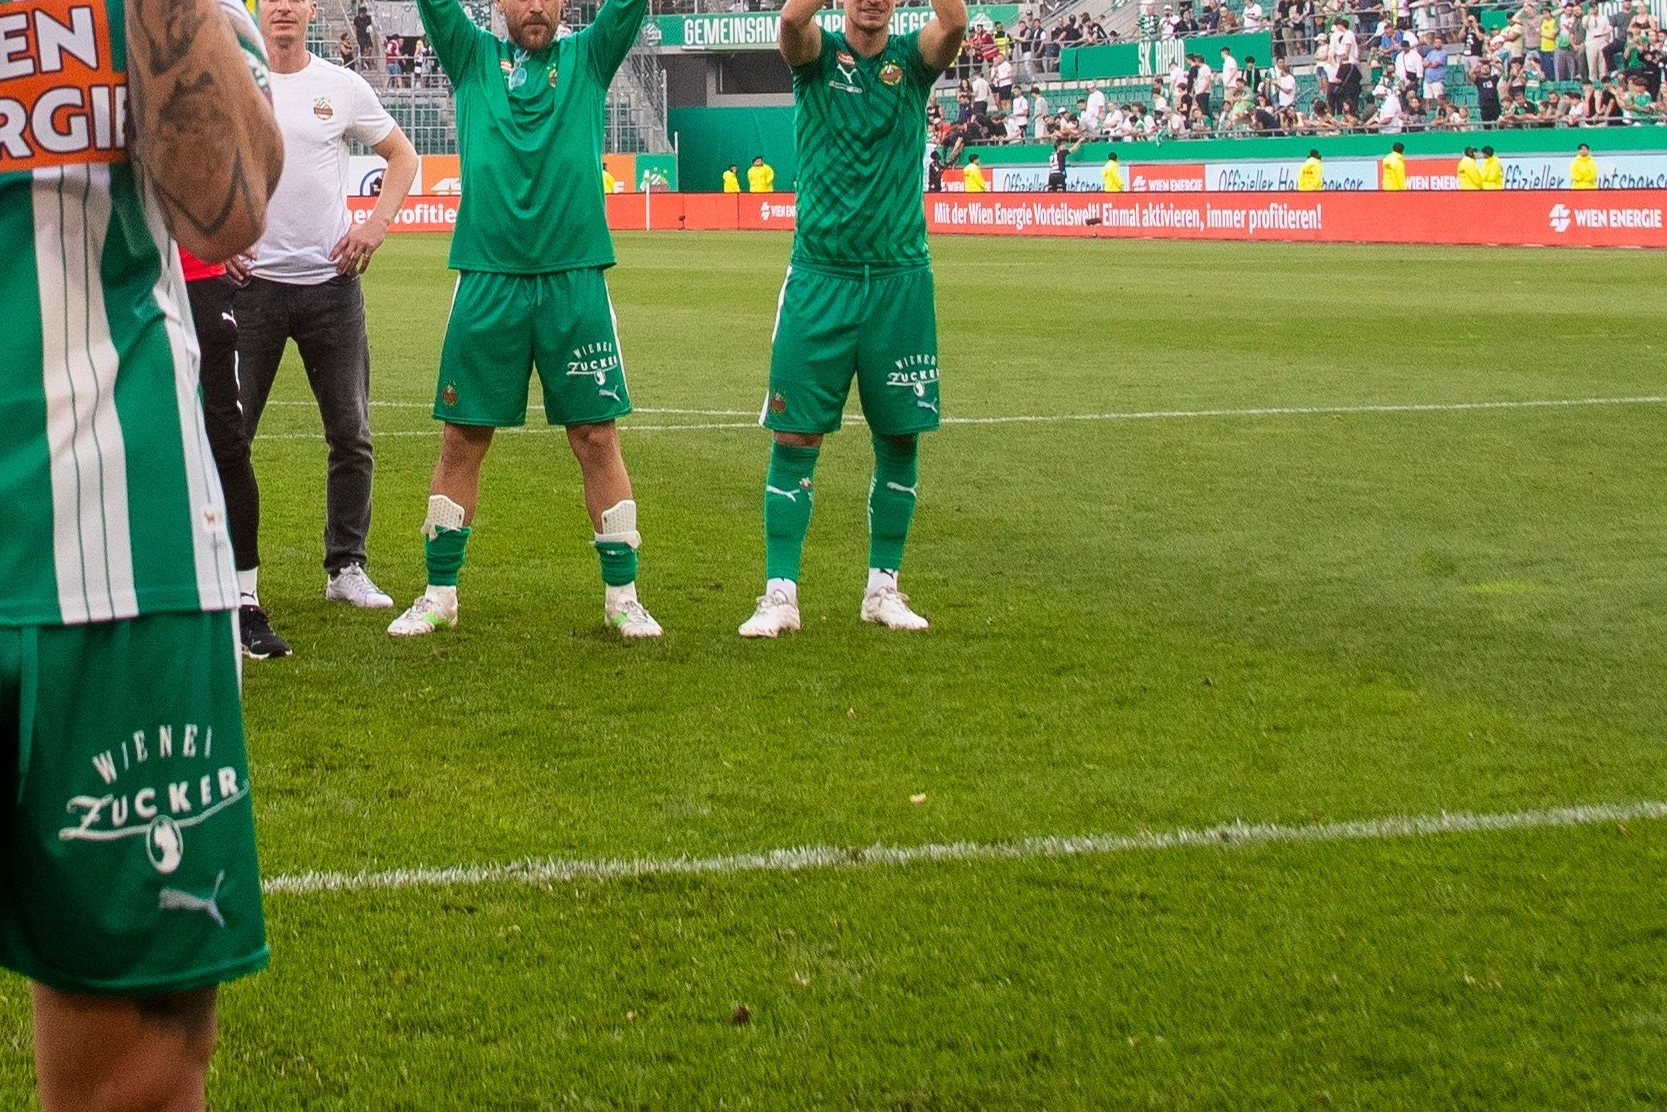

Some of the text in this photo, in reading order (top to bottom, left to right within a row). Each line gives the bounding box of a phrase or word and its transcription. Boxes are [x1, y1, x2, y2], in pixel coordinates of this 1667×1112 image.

[684, 16, 782, 45] GEMEINSAM
[1138, 38, 1185, 76] SK RAPID
[934, 200, 1322, 234] Mit der Wien Energie Vorteilswelt! Einmal aktivieren, immer profitieren!
[1574, 208, 1663, 229] WIEN ENERGIE
